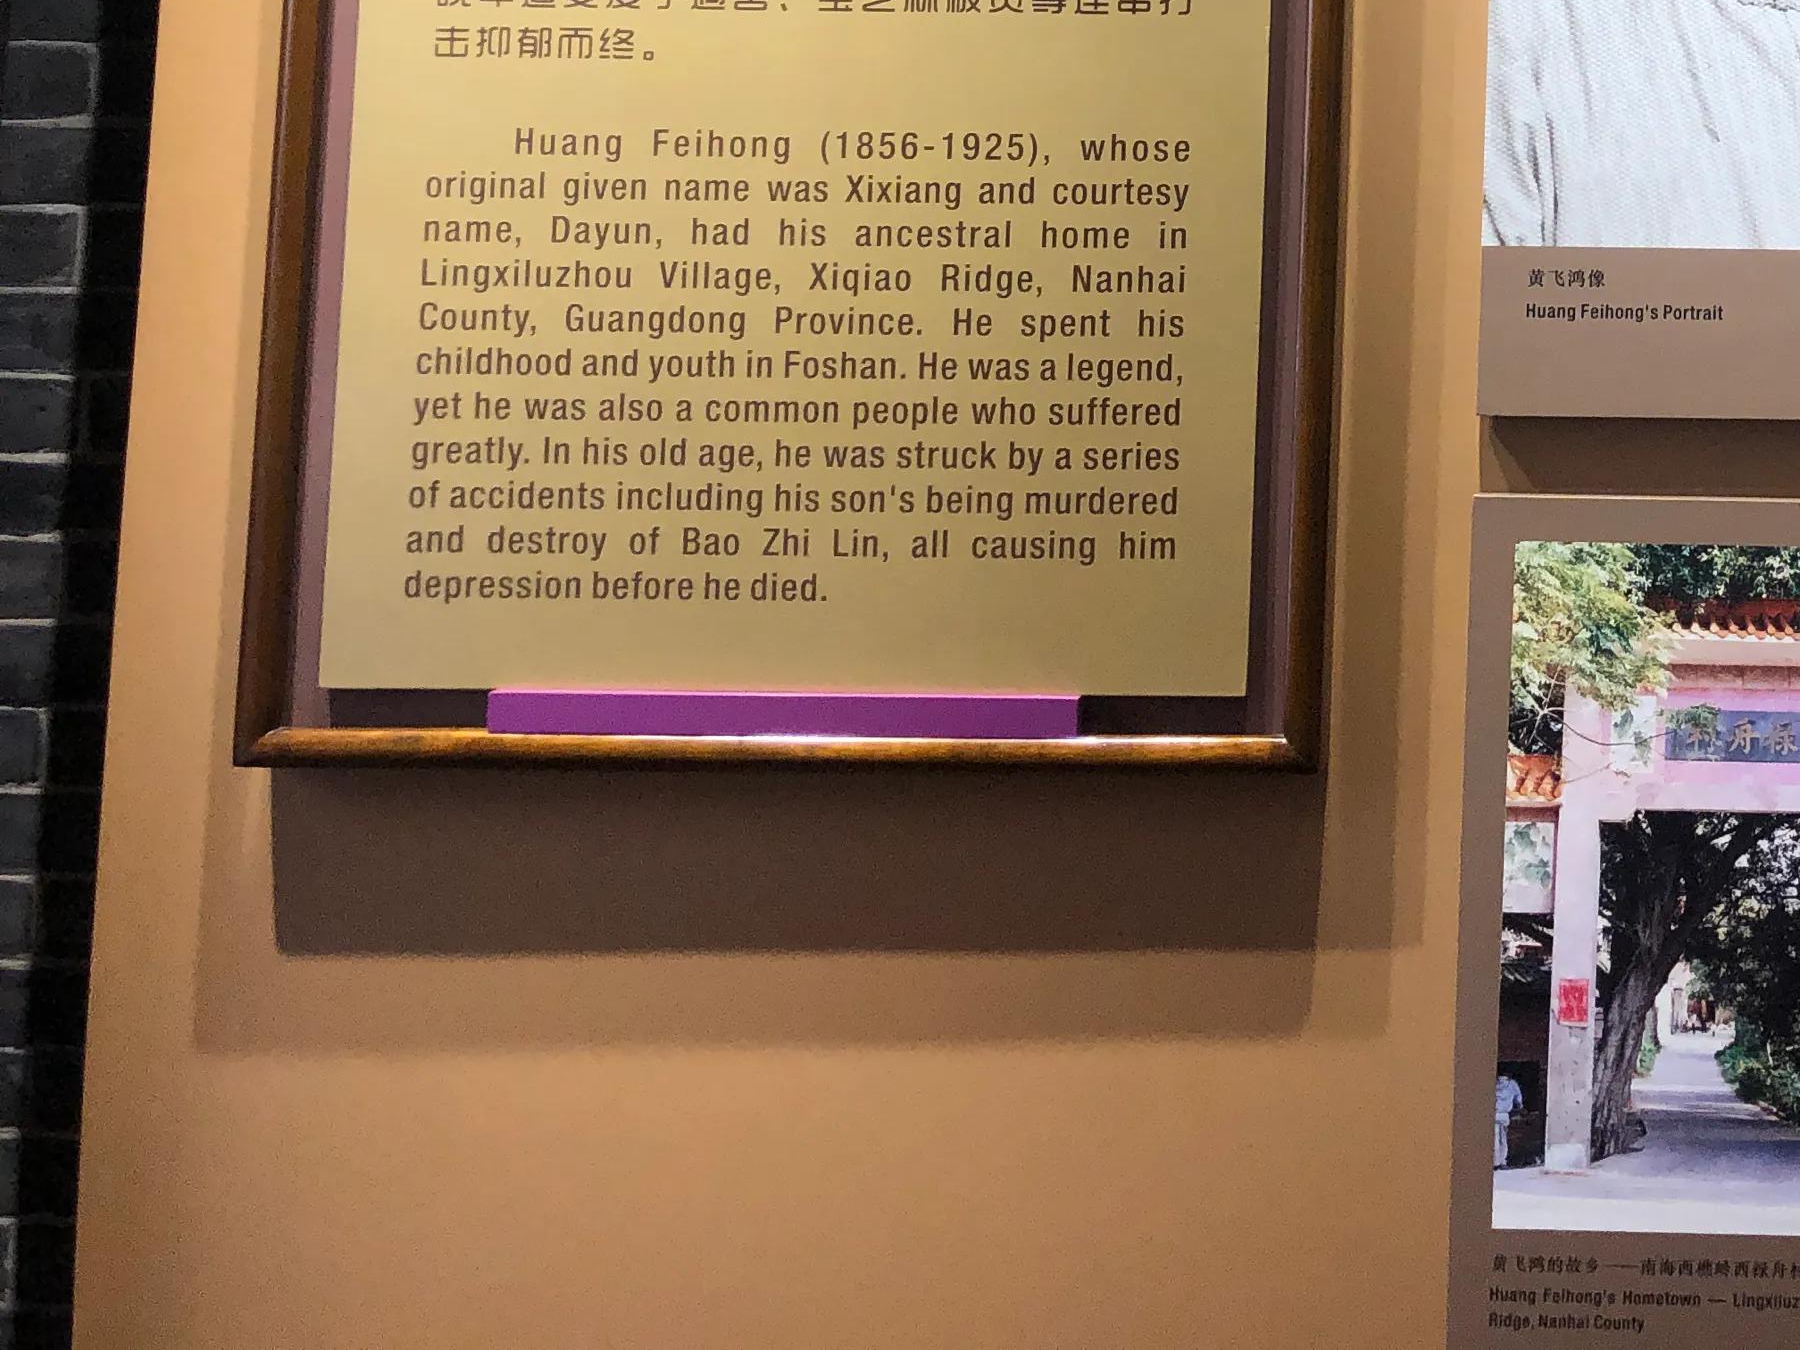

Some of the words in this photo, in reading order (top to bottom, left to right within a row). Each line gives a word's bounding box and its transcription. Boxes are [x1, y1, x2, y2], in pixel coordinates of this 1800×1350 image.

[515, 127, 622, 163] Huang
[653, 129, 790, 165] Feihong
[821, 130, 1050, 168] (1856-1925),
[1080, 133, 1190, 163] whose
[426, 170, 545, 205] original
[563, 171, 646, 206] given
[665, 179, 749, 202] name
[767, 180, 828, 203] was
[845, 174, 961, 211] Xixiang
[978, 176, 1035, 205] and
[1053, 178, 1189, 213] courtesy
[424, 220, 521, 248] name,
[551, 215, 662, 251] Dayun,
[692, 217, 749, 246] had
[779, 217, 826, 247] his
[855, 220, 1011, 249] ancestral
[1041, 220, 1129, 249] home
[1159, 221, 1187, 250] in
[421, 258, 632, 294] Lingxiluzhou
[660, 260, 780, 297] Village,
[809, 262, 911, 297] Xiqiao
[941, 263, 1042, 299] Ridge,
[1072, 264, 1186, 294] Nanhai
[1528, 268, 1605, 288] 黄飞鸿像
[419, 302, 536, 338] County,
[565, 303, 745, 341] Guangdong
[775, 306, 922, 336] Province.
[953, 307, 992, 337] He
[1021, 309, 1111, 343] spent
[1138, 309, 1184, 338] his
[1526, 303, 1576, 322] Huang
[1581, 303, 1659, 323] Feihong's
[1663, 304, 1723, 321] Portrait
[416, 346, 572, 377] childhood
[582, 349, 638, 377] and
[648, 349, 735, 384] youth
[746, 349, 773, 379] in
[784, 350, 906, 380] Foshan.
[919, 351, 958, 380] He
[968, 358, 1030, 381] was
[1040, 358, 1056, 381] a
[1067, 352, 1183, 388] legend,
[413, 392, 462, 426] yet
[474, 391, 511, 420] he
[524, 398, 586, 421] was
[598, 393, 663, 422] also
[676, 399, 692, 422] a
[705, 399, 839, 423] common
[853, 396, 958, 431] people
[971, 396, 1036, 425] who
[1048, 396, 1181, 427] suffered
[404, 569, 581, 605] depression
[592, 570, 694, 600] before
[704, 572, 740, 601] he
[750, 572, 827, 602] died.
